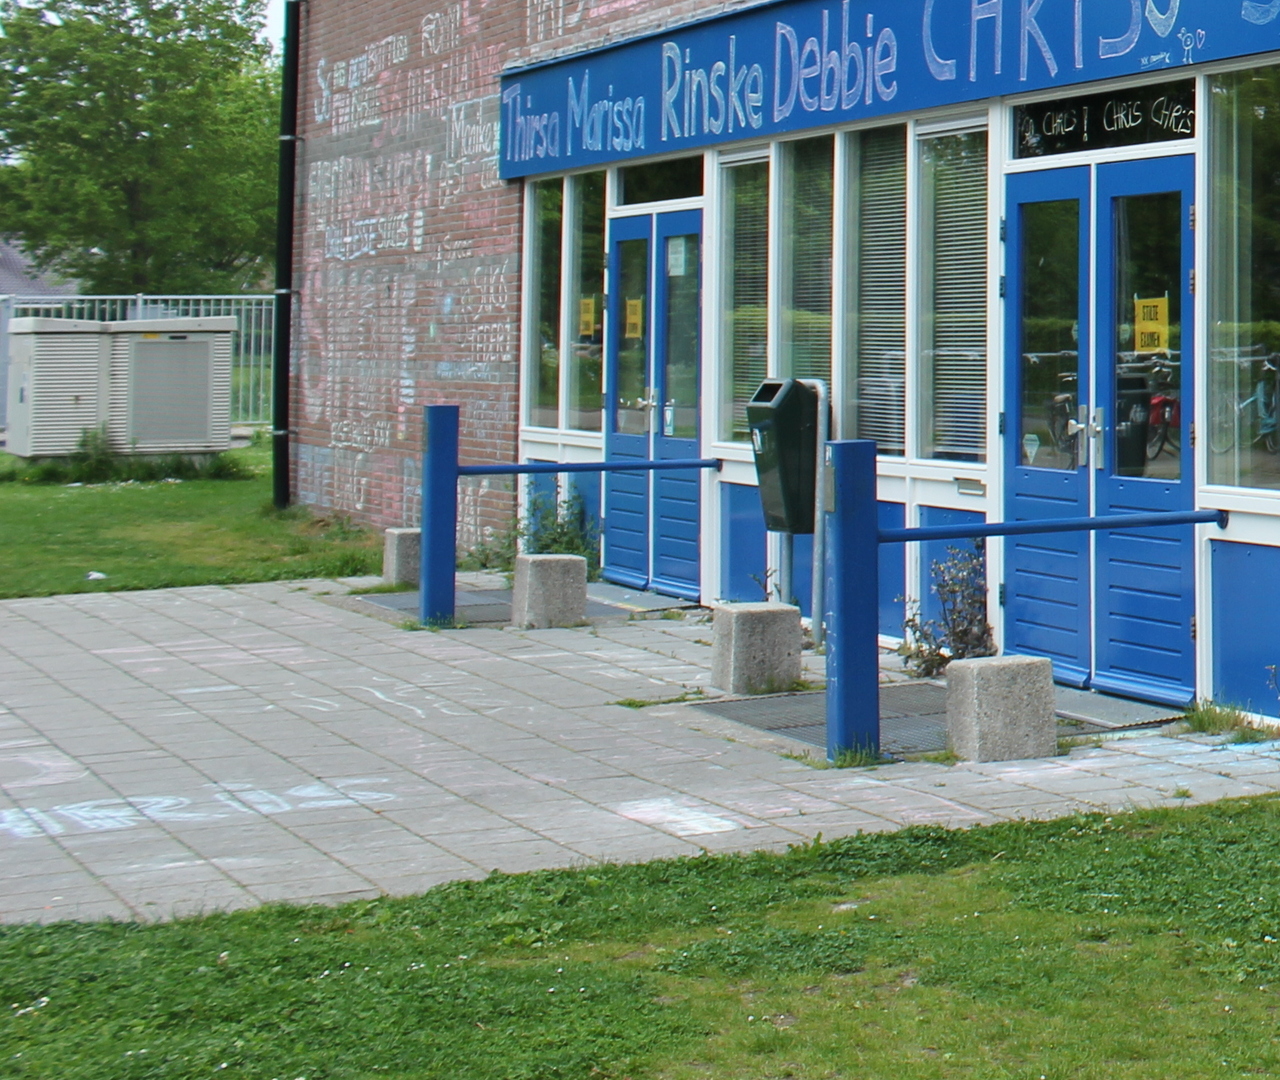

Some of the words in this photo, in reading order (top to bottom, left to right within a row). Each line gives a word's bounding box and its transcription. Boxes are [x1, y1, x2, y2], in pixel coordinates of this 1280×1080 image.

[503, 83, 559, 161] Thirsa
[566, 69, 645, 156] Marissa
[661, 35, 763, 141] Rinske
[773, 0, 898, 123] Debbie
